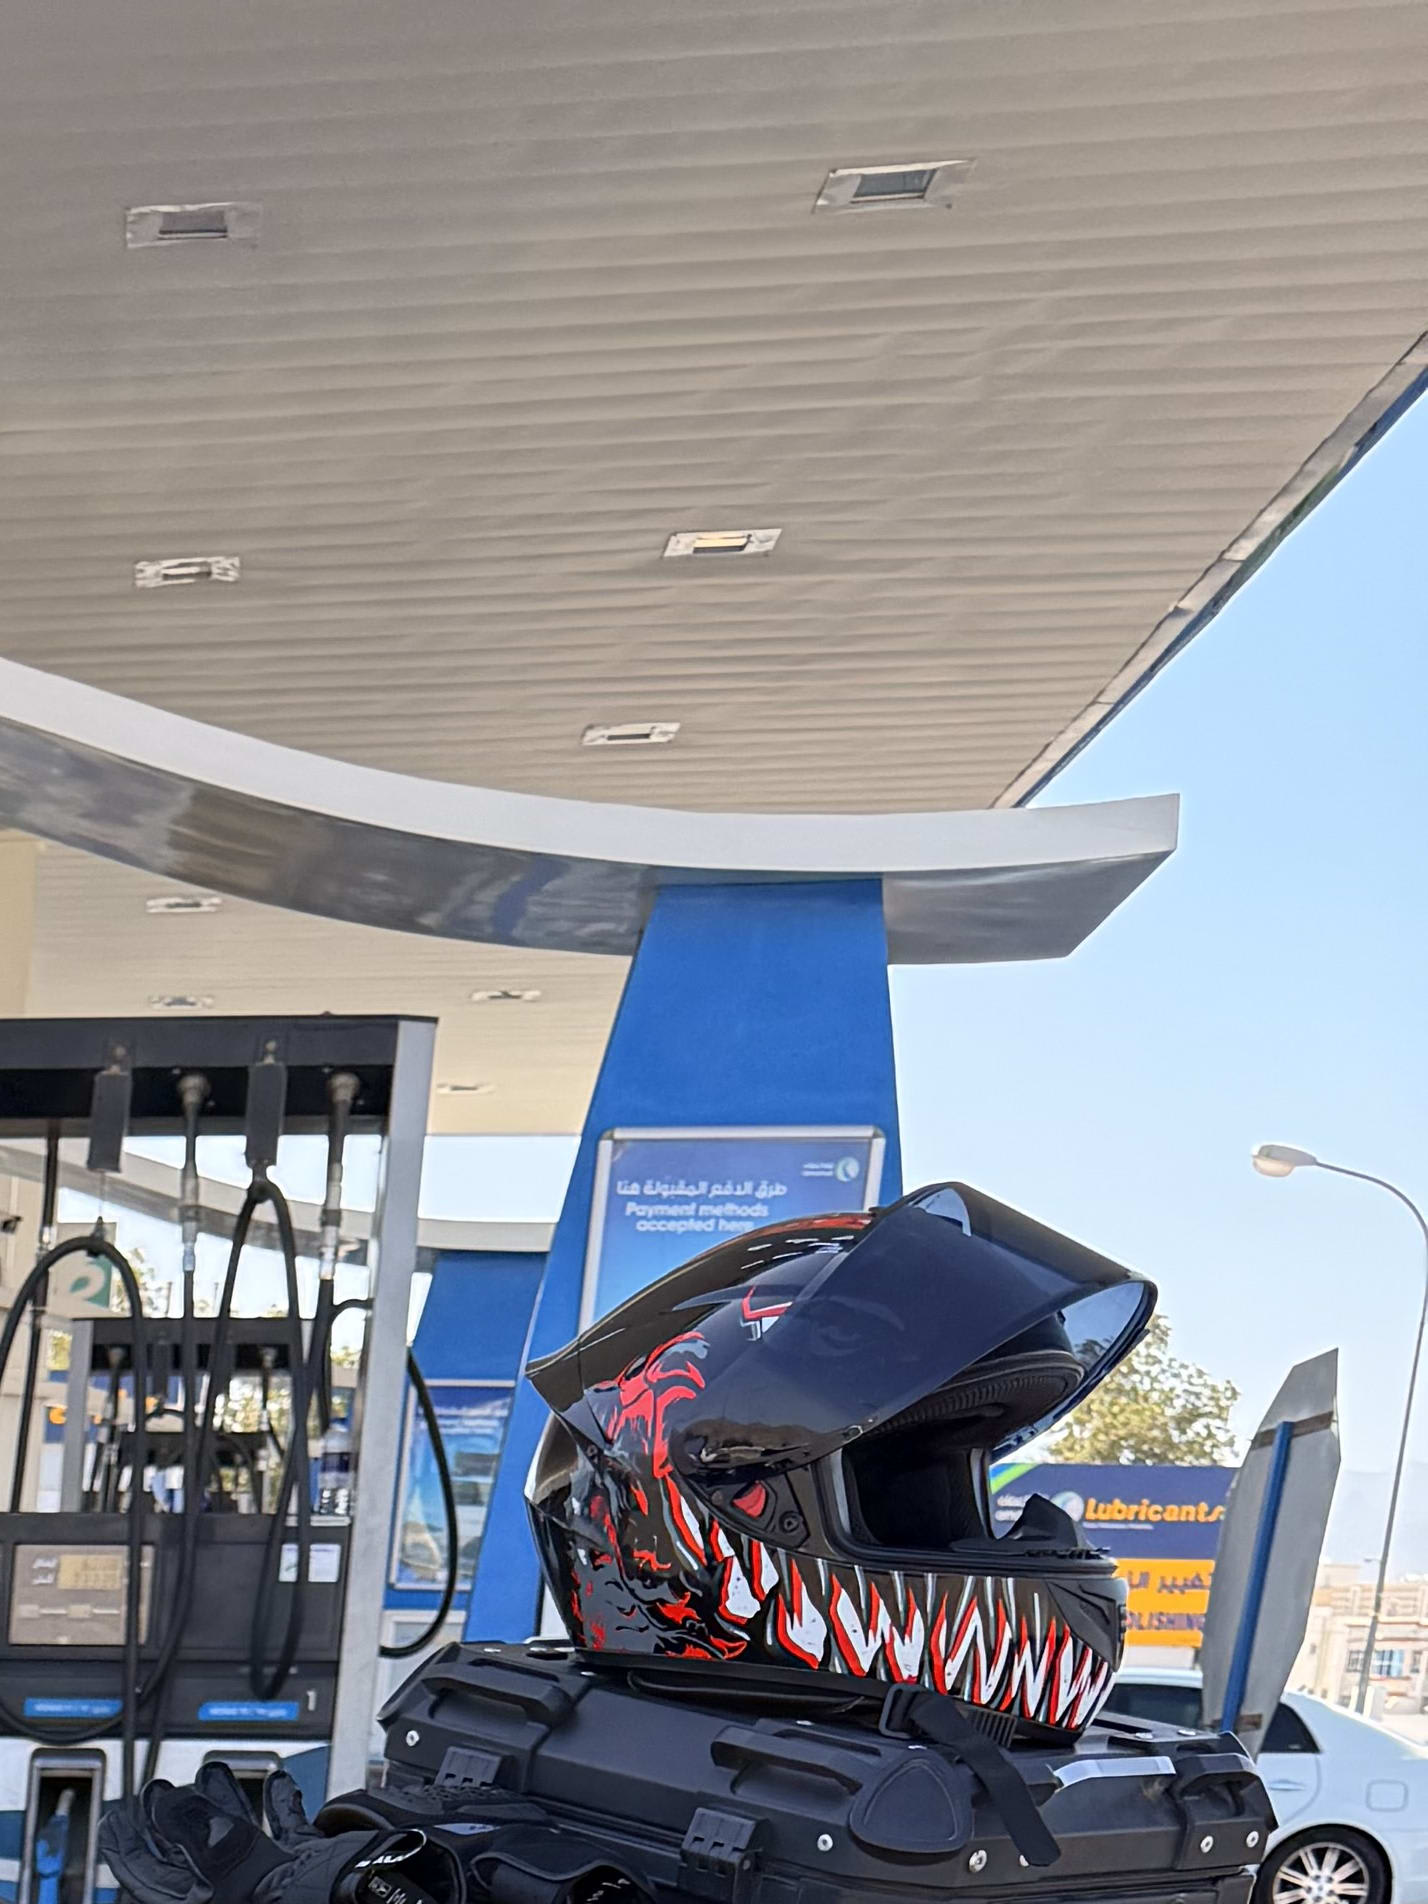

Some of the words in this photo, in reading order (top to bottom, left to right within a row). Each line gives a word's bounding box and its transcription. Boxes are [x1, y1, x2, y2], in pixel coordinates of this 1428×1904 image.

[625, 1201, 695, 1218] Payment
[698, 1202, 769, 1217] methods
[636, 1218, 714, 1233] accepted
[306, 1689, 316, 1711] 1
